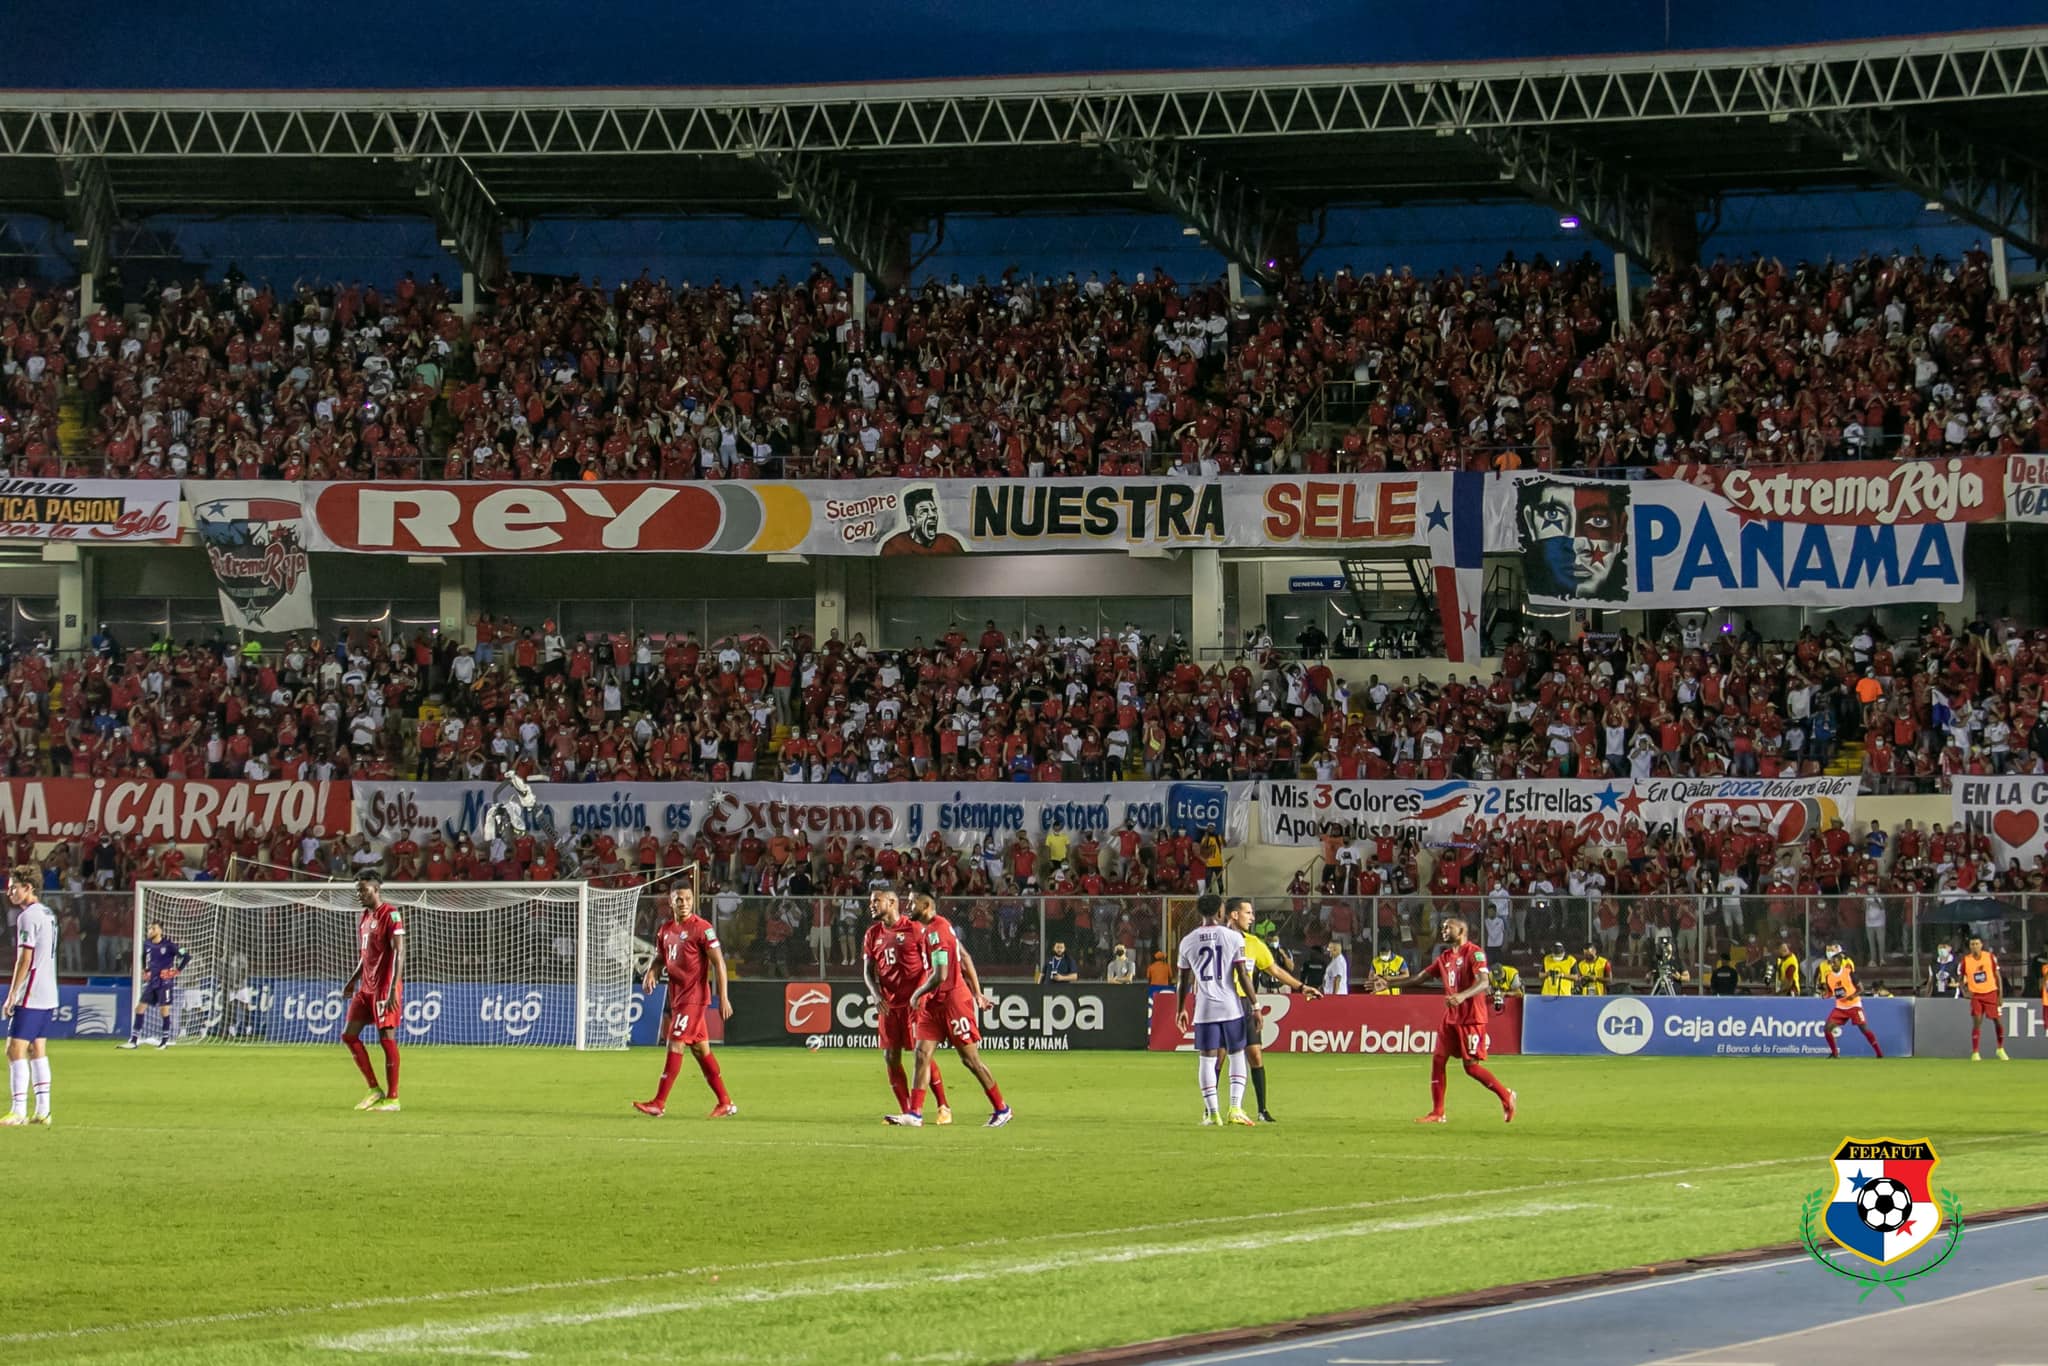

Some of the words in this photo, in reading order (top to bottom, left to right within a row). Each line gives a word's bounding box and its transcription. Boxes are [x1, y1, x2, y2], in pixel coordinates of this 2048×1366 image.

[1875, 459, 1984, 524] Roja
[0, 496, 38, 523] ICA
[46, 499, 120, 523] PASION
[826, 492, 897, 520] Siempre
[970, 483, 1226, 543] NUESTRA
[1263, 481, 1418, 542] SELE
[843, 518, 876, 541] con
[1333, 580, 1341, 588] 2
[1271, 784, 1308, 808] Mis
[1313, 784, 1333, 809] 3
[1334, 787, 1421, 812] Colores
[1473, 794, 1485, 815] y
[1484, 786, 1501, 814] 2
[1504, 786, 1593, 813] Estrellas
[1671, 780, 1720, 804] Qatar
[1718, 779, 1762, 798] 2022
[1962, 782, 1991, 805] EN
[1996, 782, 2022, 805] LA
[665, 801, 692, 830] es
[906, 800, 924, 842] y
[938, 791, 1025, 839] siempre
[1965, 810, 1992, 834] MI
[885, 948, 896, 965] 15
[1199, 945, 1223, 981] 21
[674, 1014, 689, 1031] 14
[836, 987, 1104, 1036] cate.pa
[951, 1017, 970, 1035] 20
[1664, 1015, 1714, 1043] Caja
[1718, 1016, 1747, 1037] de
[847, 1035, 880, 1049] OFICIA
[1013, 1036, 1025, 1049] DE
[1029, 1034, 1069, 1050] PANAMÁ
[1291, 1031, 1354, 1053] new
[1360, 1025, 1490, 1053] bala
[1467, 1033, 1480, 1050] 19
[1726, 1044, 1750, 1053] Banco
